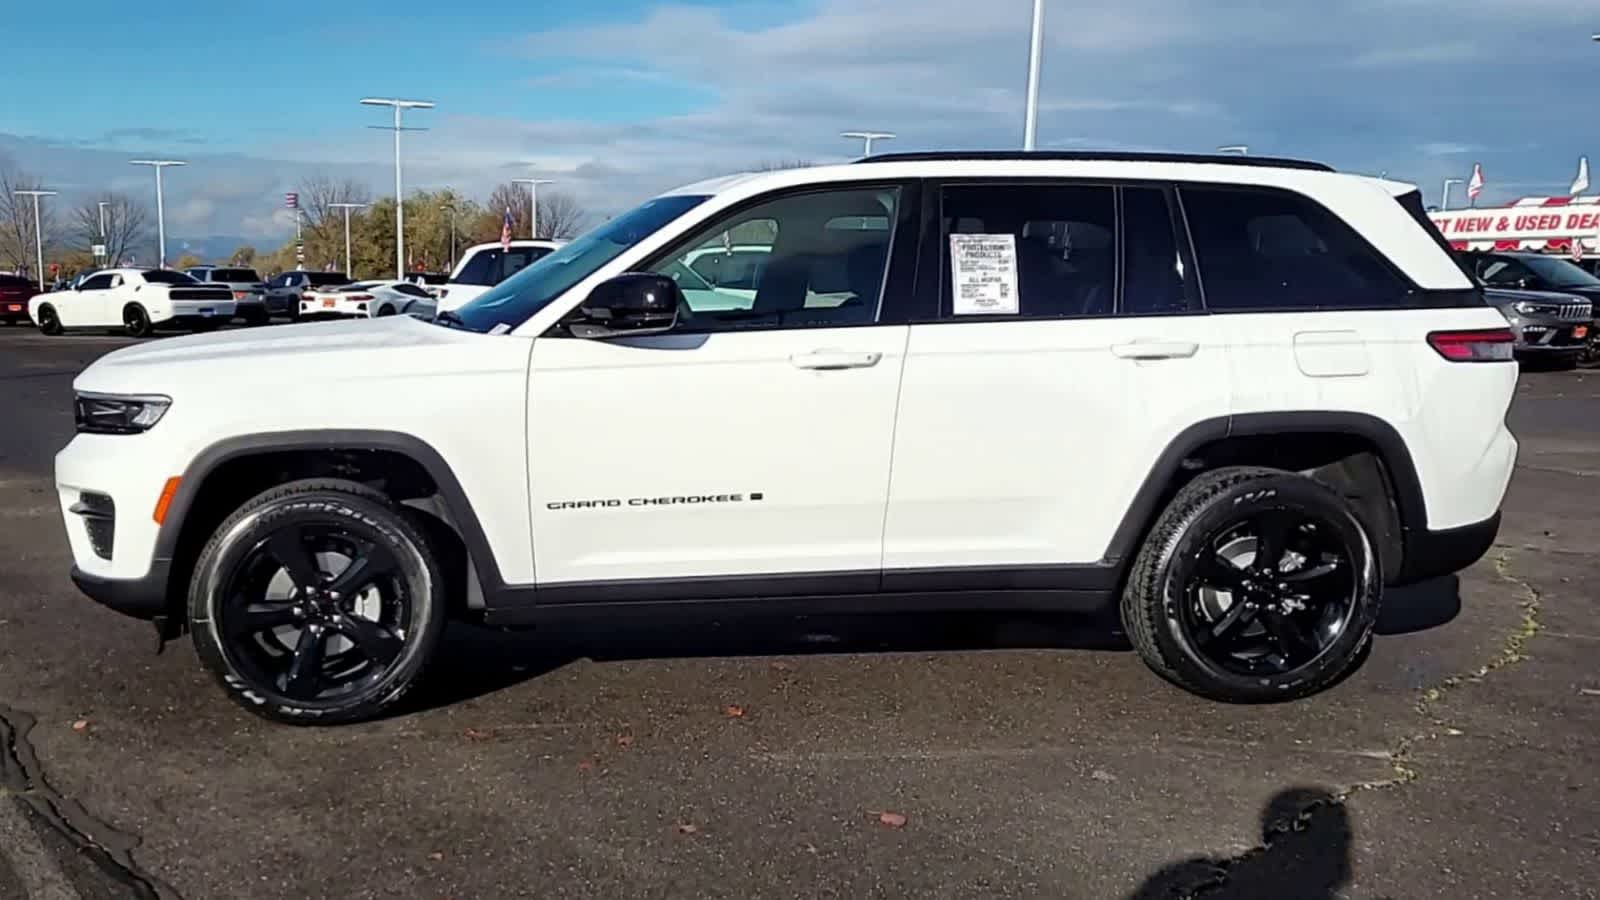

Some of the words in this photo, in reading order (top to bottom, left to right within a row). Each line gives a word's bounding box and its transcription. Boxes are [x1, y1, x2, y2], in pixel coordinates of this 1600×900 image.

[1453, 216, 1494, 233] NEW
[1495, 216, 1509, 232] &
[1514, 214, 1561, 231] USED
[546, 499, 621, 511] GRAND
[627, 494, 743, 507] CHEROKEE
